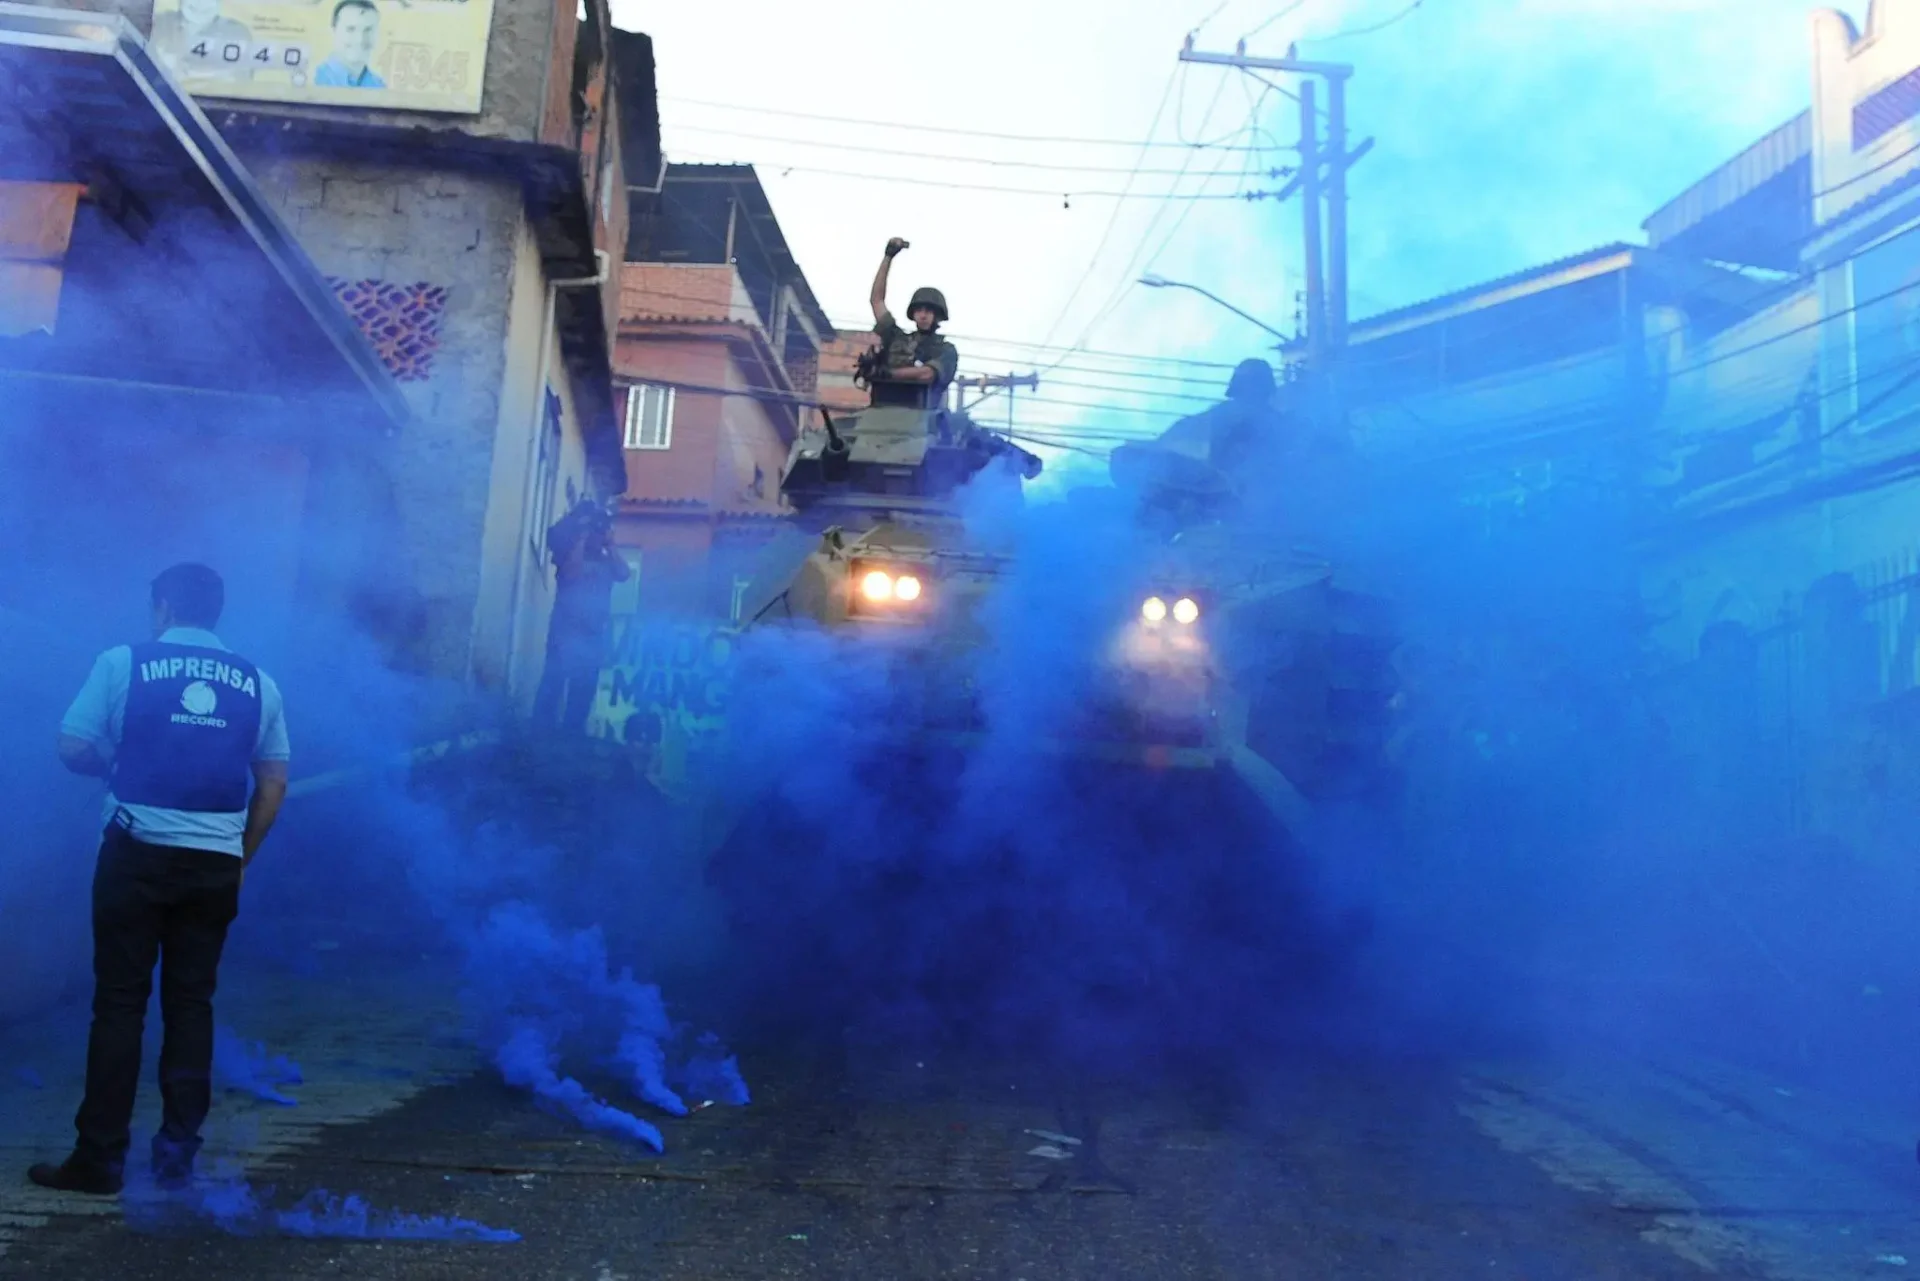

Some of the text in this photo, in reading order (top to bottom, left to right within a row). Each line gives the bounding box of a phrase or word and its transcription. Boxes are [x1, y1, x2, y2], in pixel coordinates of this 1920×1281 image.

[192, 42, 301, 66] 4040
[140, 656, 256, 698] IMPRENSA
[171, 713, 228, 729] RECORD
